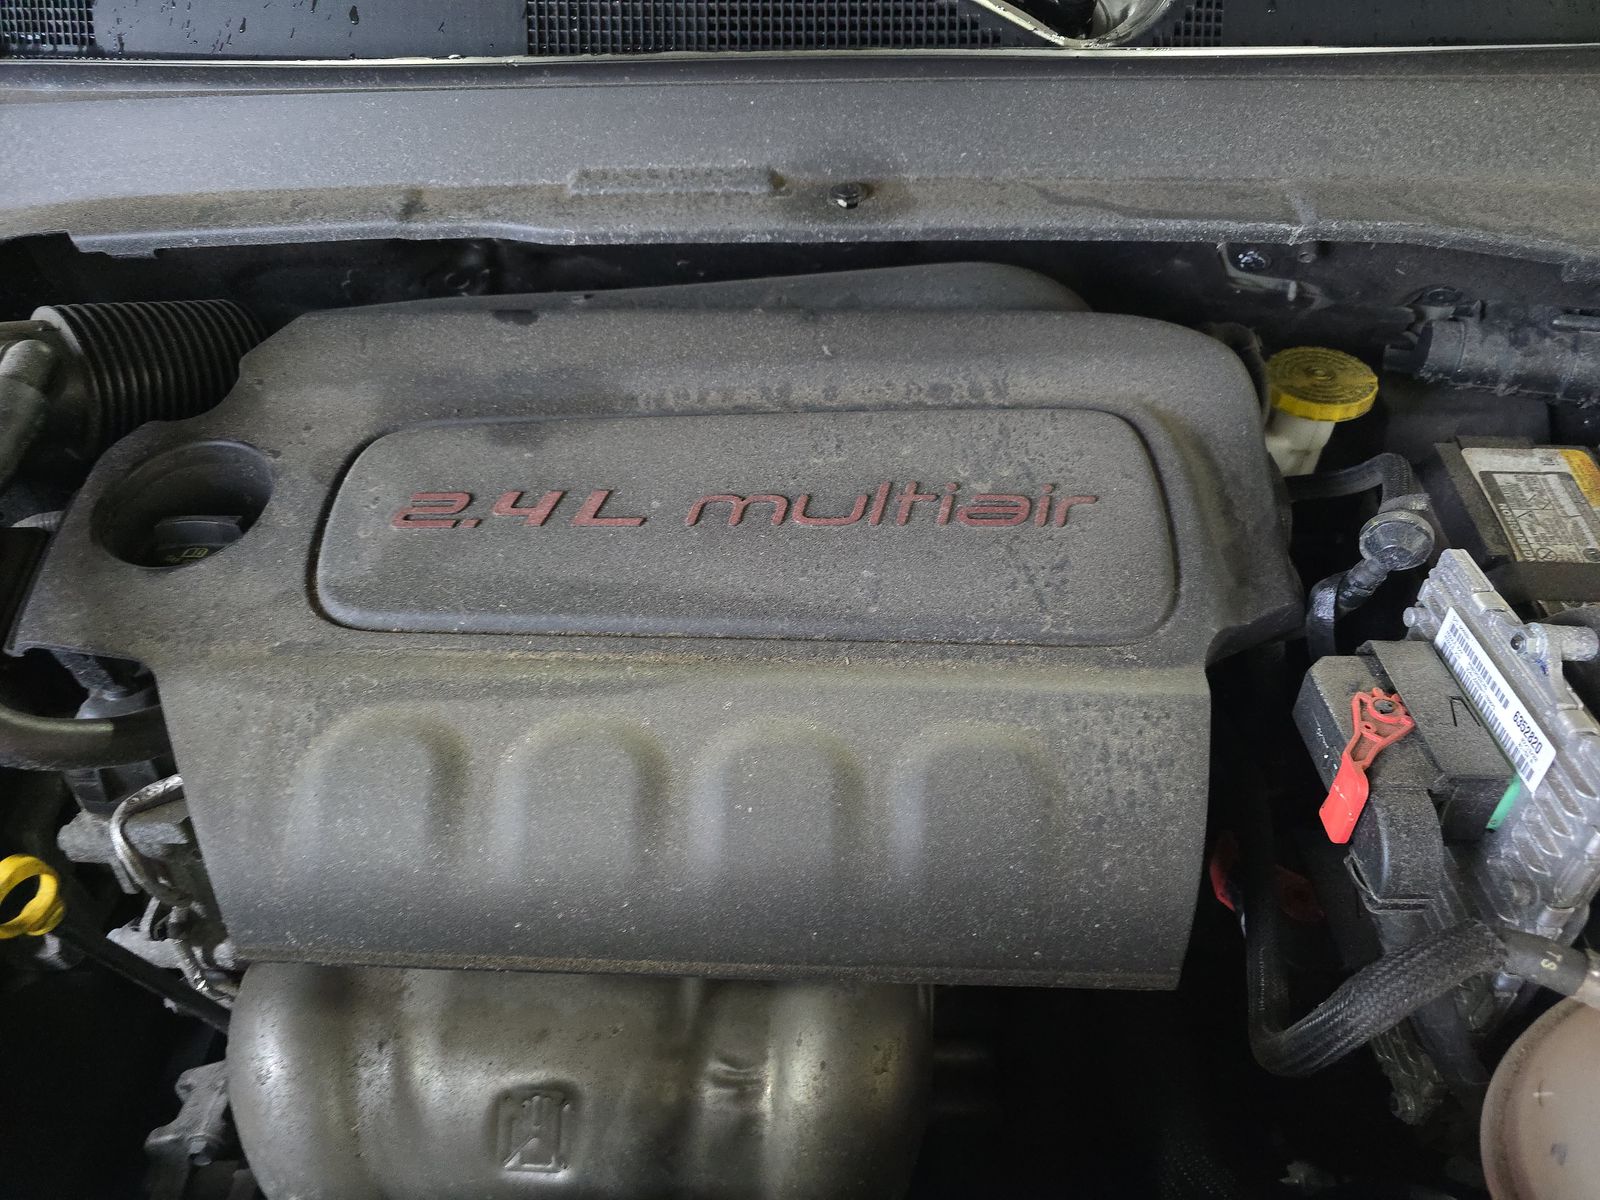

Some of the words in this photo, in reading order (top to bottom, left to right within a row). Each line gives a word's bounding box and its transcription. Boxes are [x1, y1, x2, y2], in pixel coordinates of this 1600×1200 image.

[391, 489, 647, 529] 2.4L
[684, 482, 1099, 528] multiair
[1513, 711, 1543, 754] 6352820
